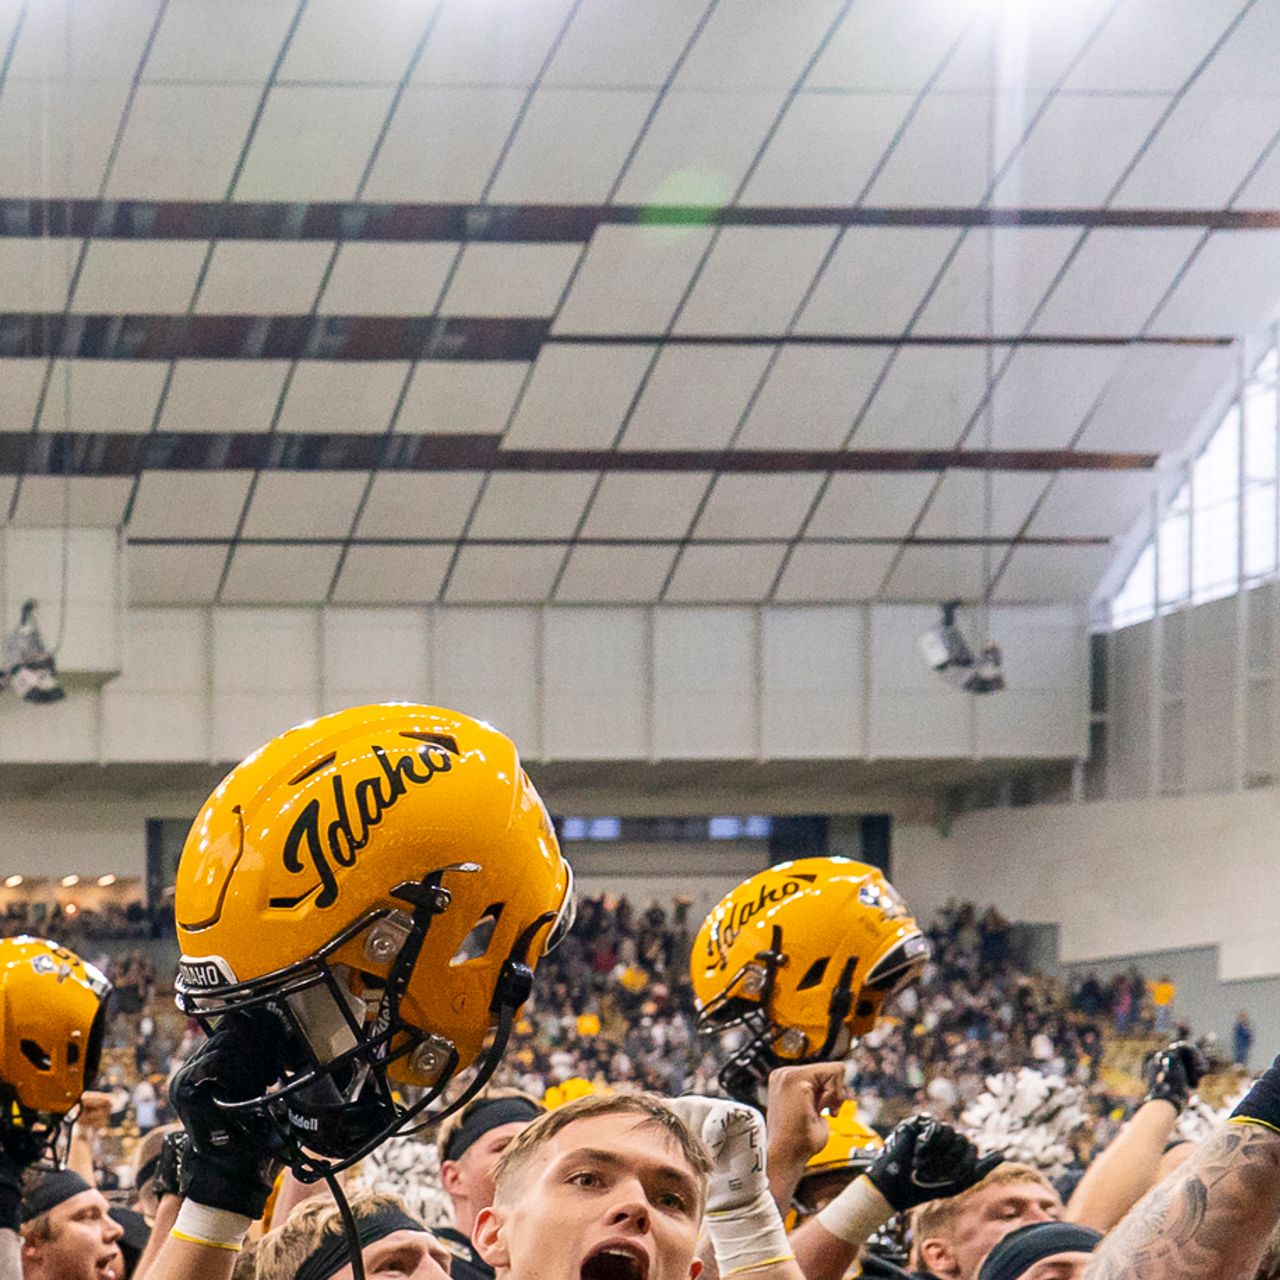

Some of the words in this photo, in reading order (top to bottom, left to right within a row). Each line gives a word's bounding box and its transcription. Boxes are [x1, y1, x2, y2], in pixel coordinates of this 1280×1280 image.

[282, 744, 452, 908] Idaho
[705, 880, 800, 972] Idaho
[288, 1108, 318, 1131] iddell
